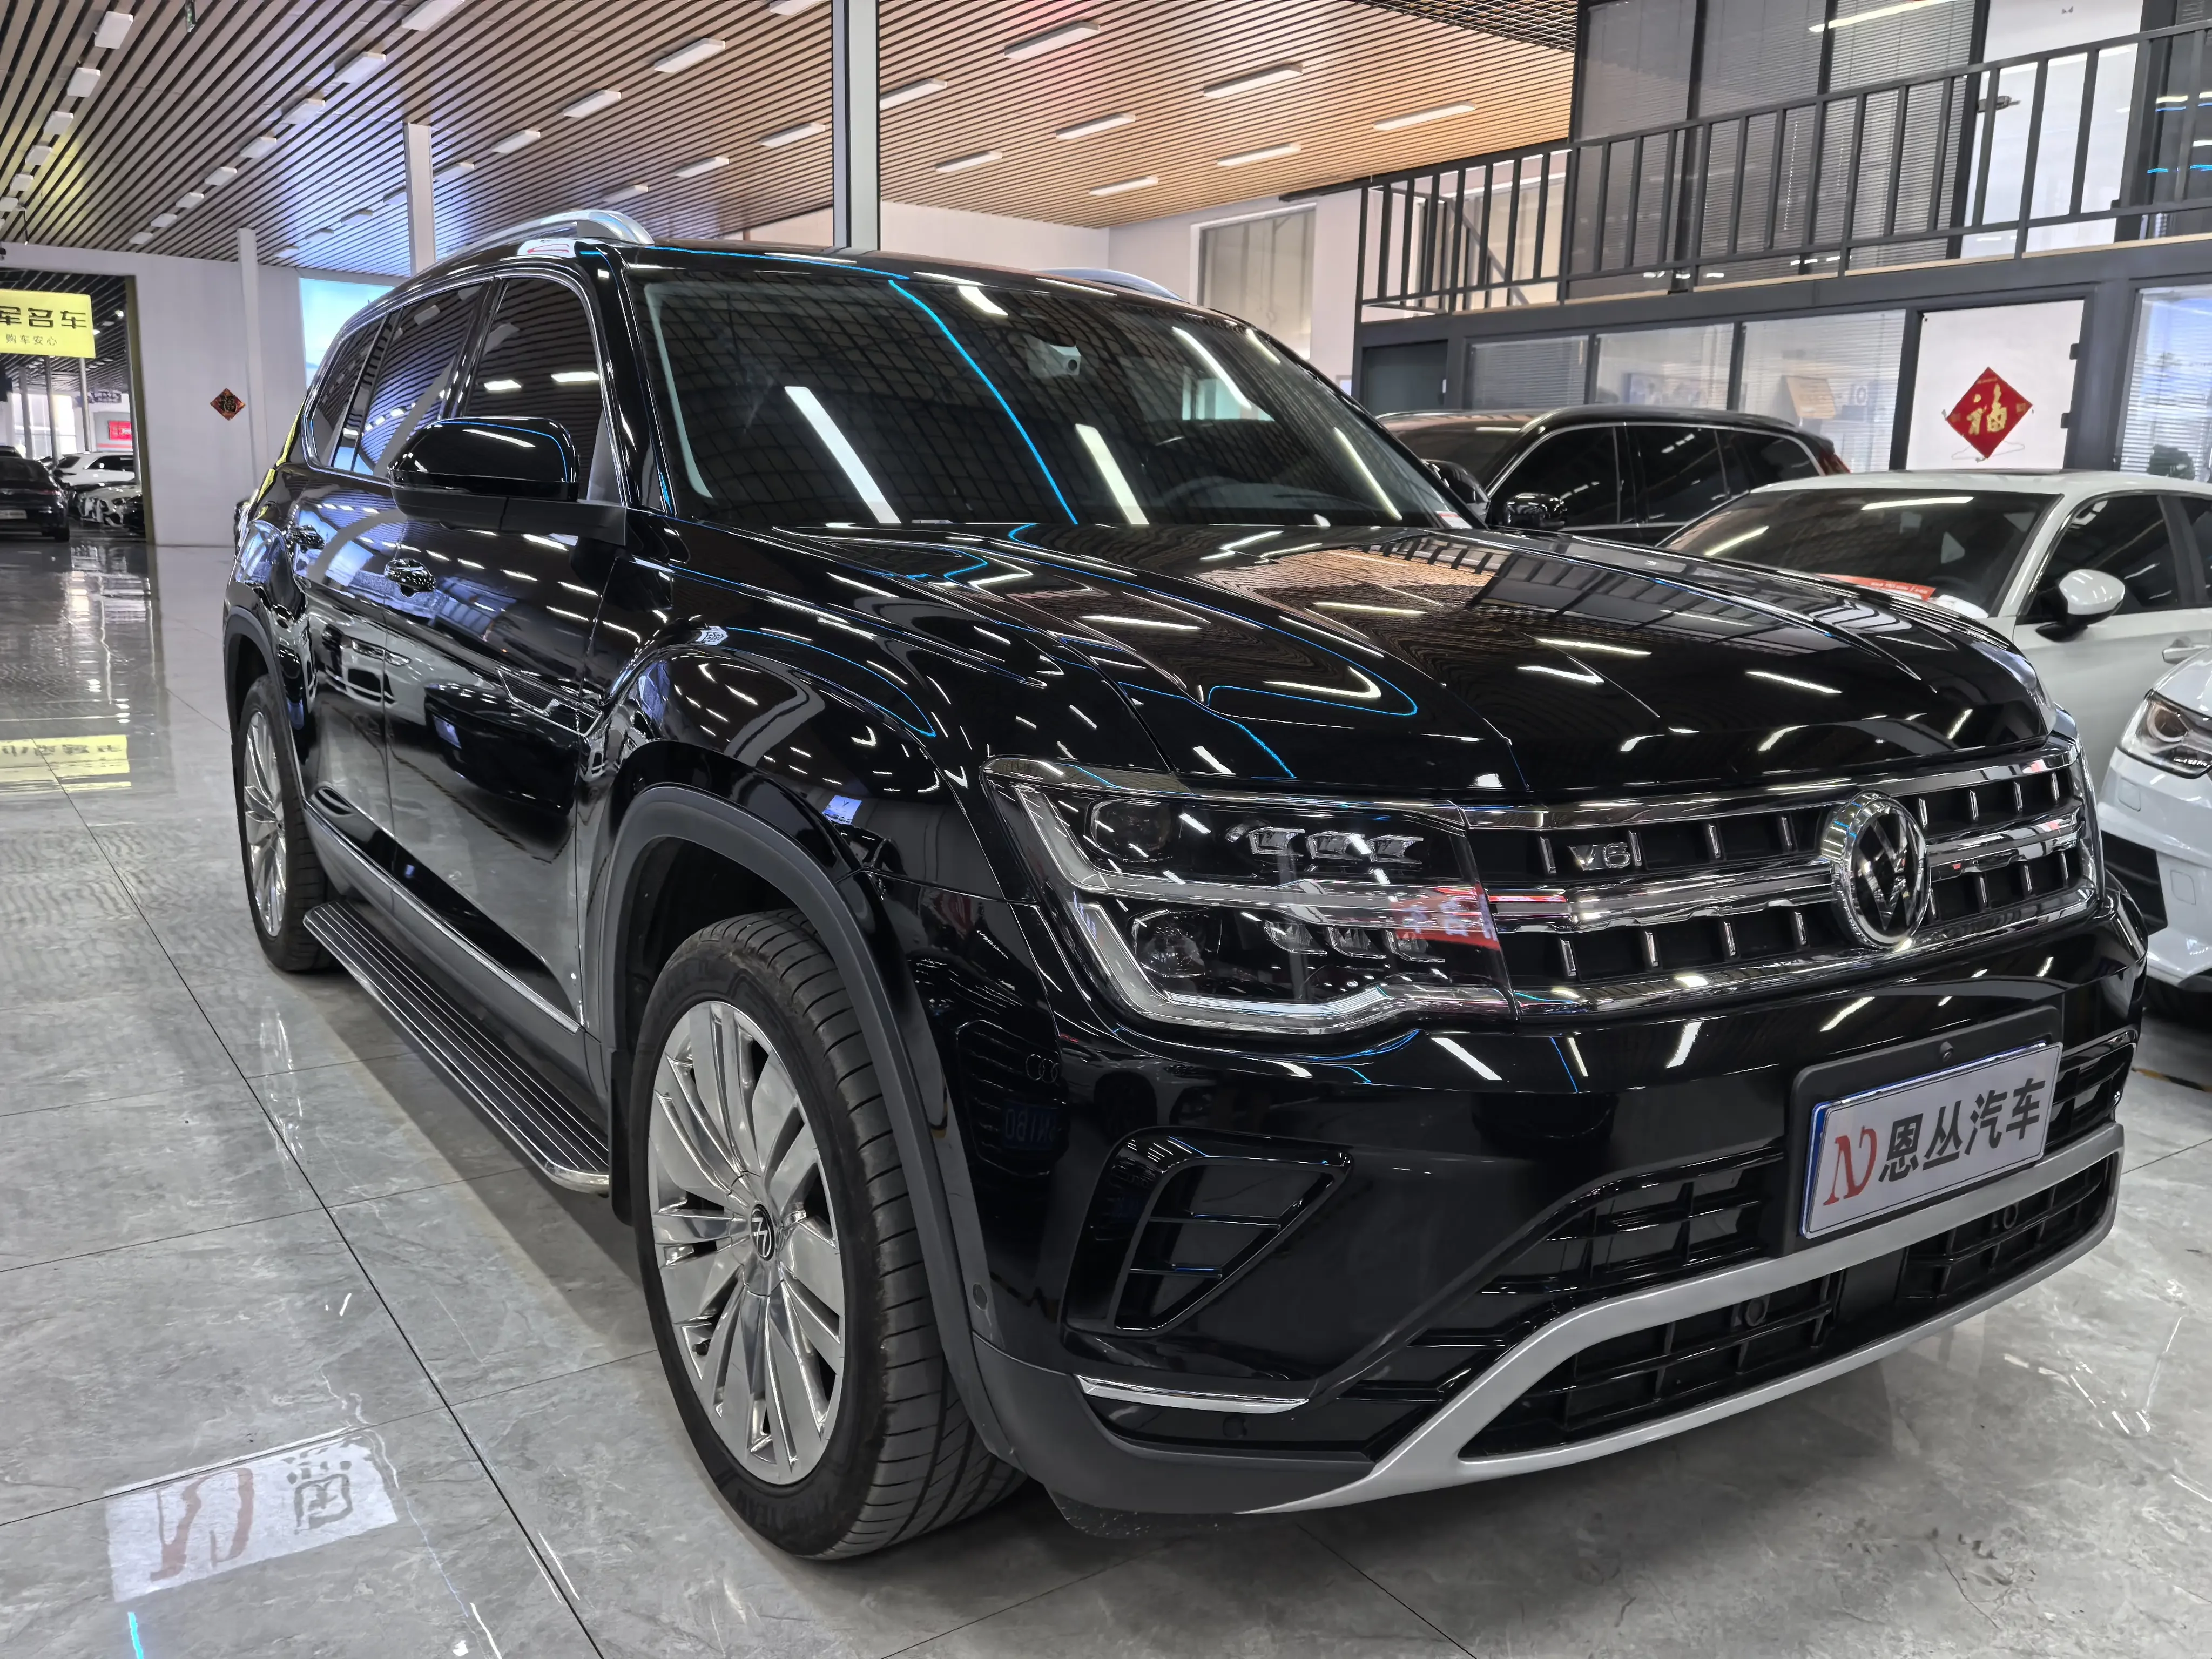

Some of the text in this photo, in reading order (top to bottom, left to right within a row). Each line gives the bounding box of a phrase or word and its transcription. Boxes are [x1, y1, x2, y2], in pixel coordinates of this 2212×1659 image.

[6, 334, 57, 346] 购车安心
[1966, 383, 2007, 436] 福
[1567, 842, 1631, 871] V6
